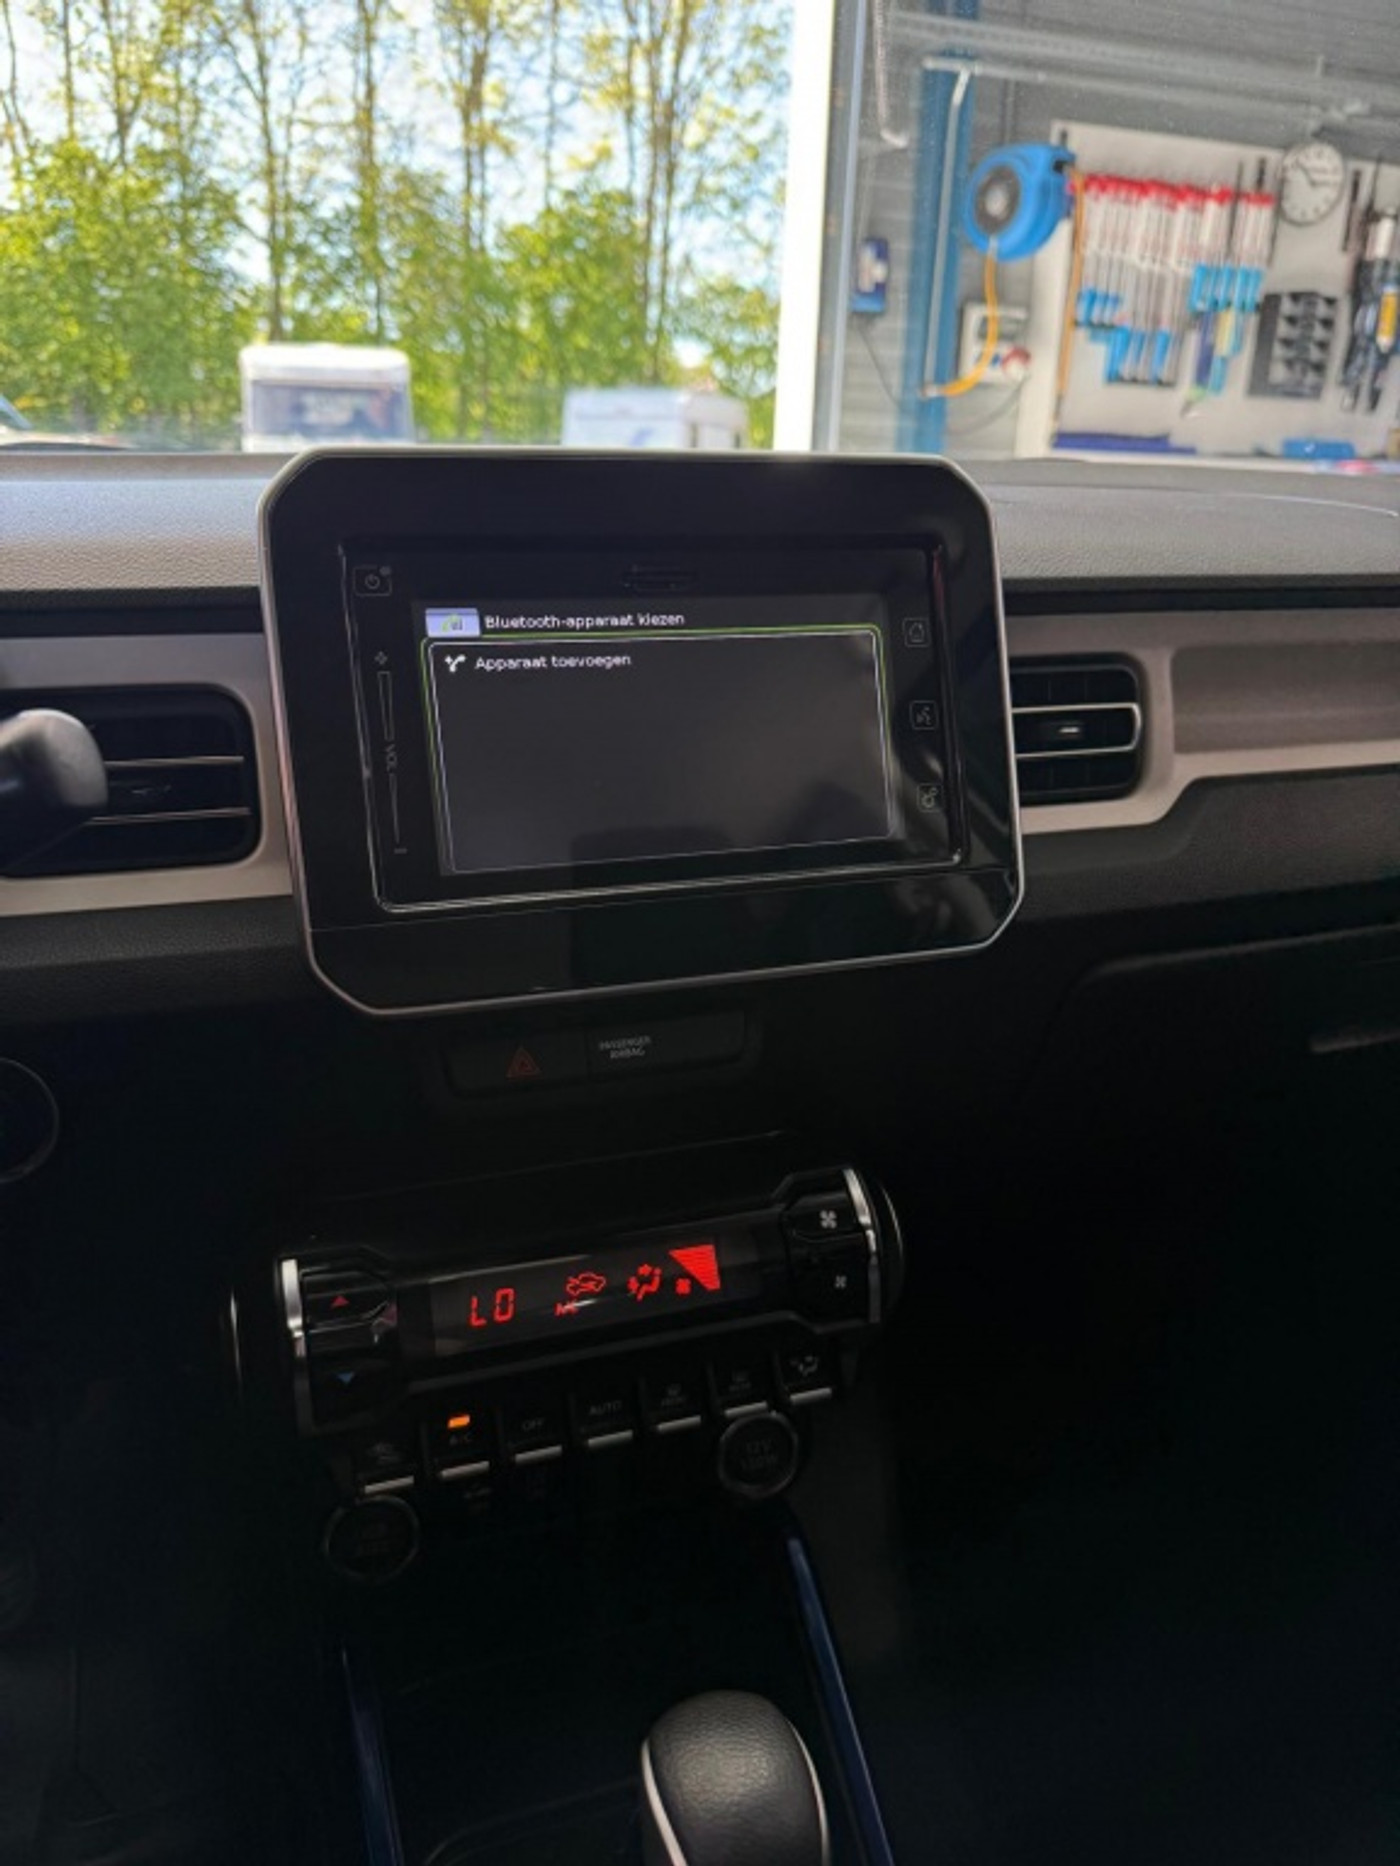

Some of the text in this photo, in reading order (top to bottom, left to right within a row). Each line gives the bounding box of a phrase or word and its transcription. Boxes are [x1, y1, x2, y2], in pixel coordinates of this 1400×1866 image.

[485, 612, 685, 630] Bluetooth-apparaat kiezen
[475, 653, 631, 671] Apparaat toevoegen
